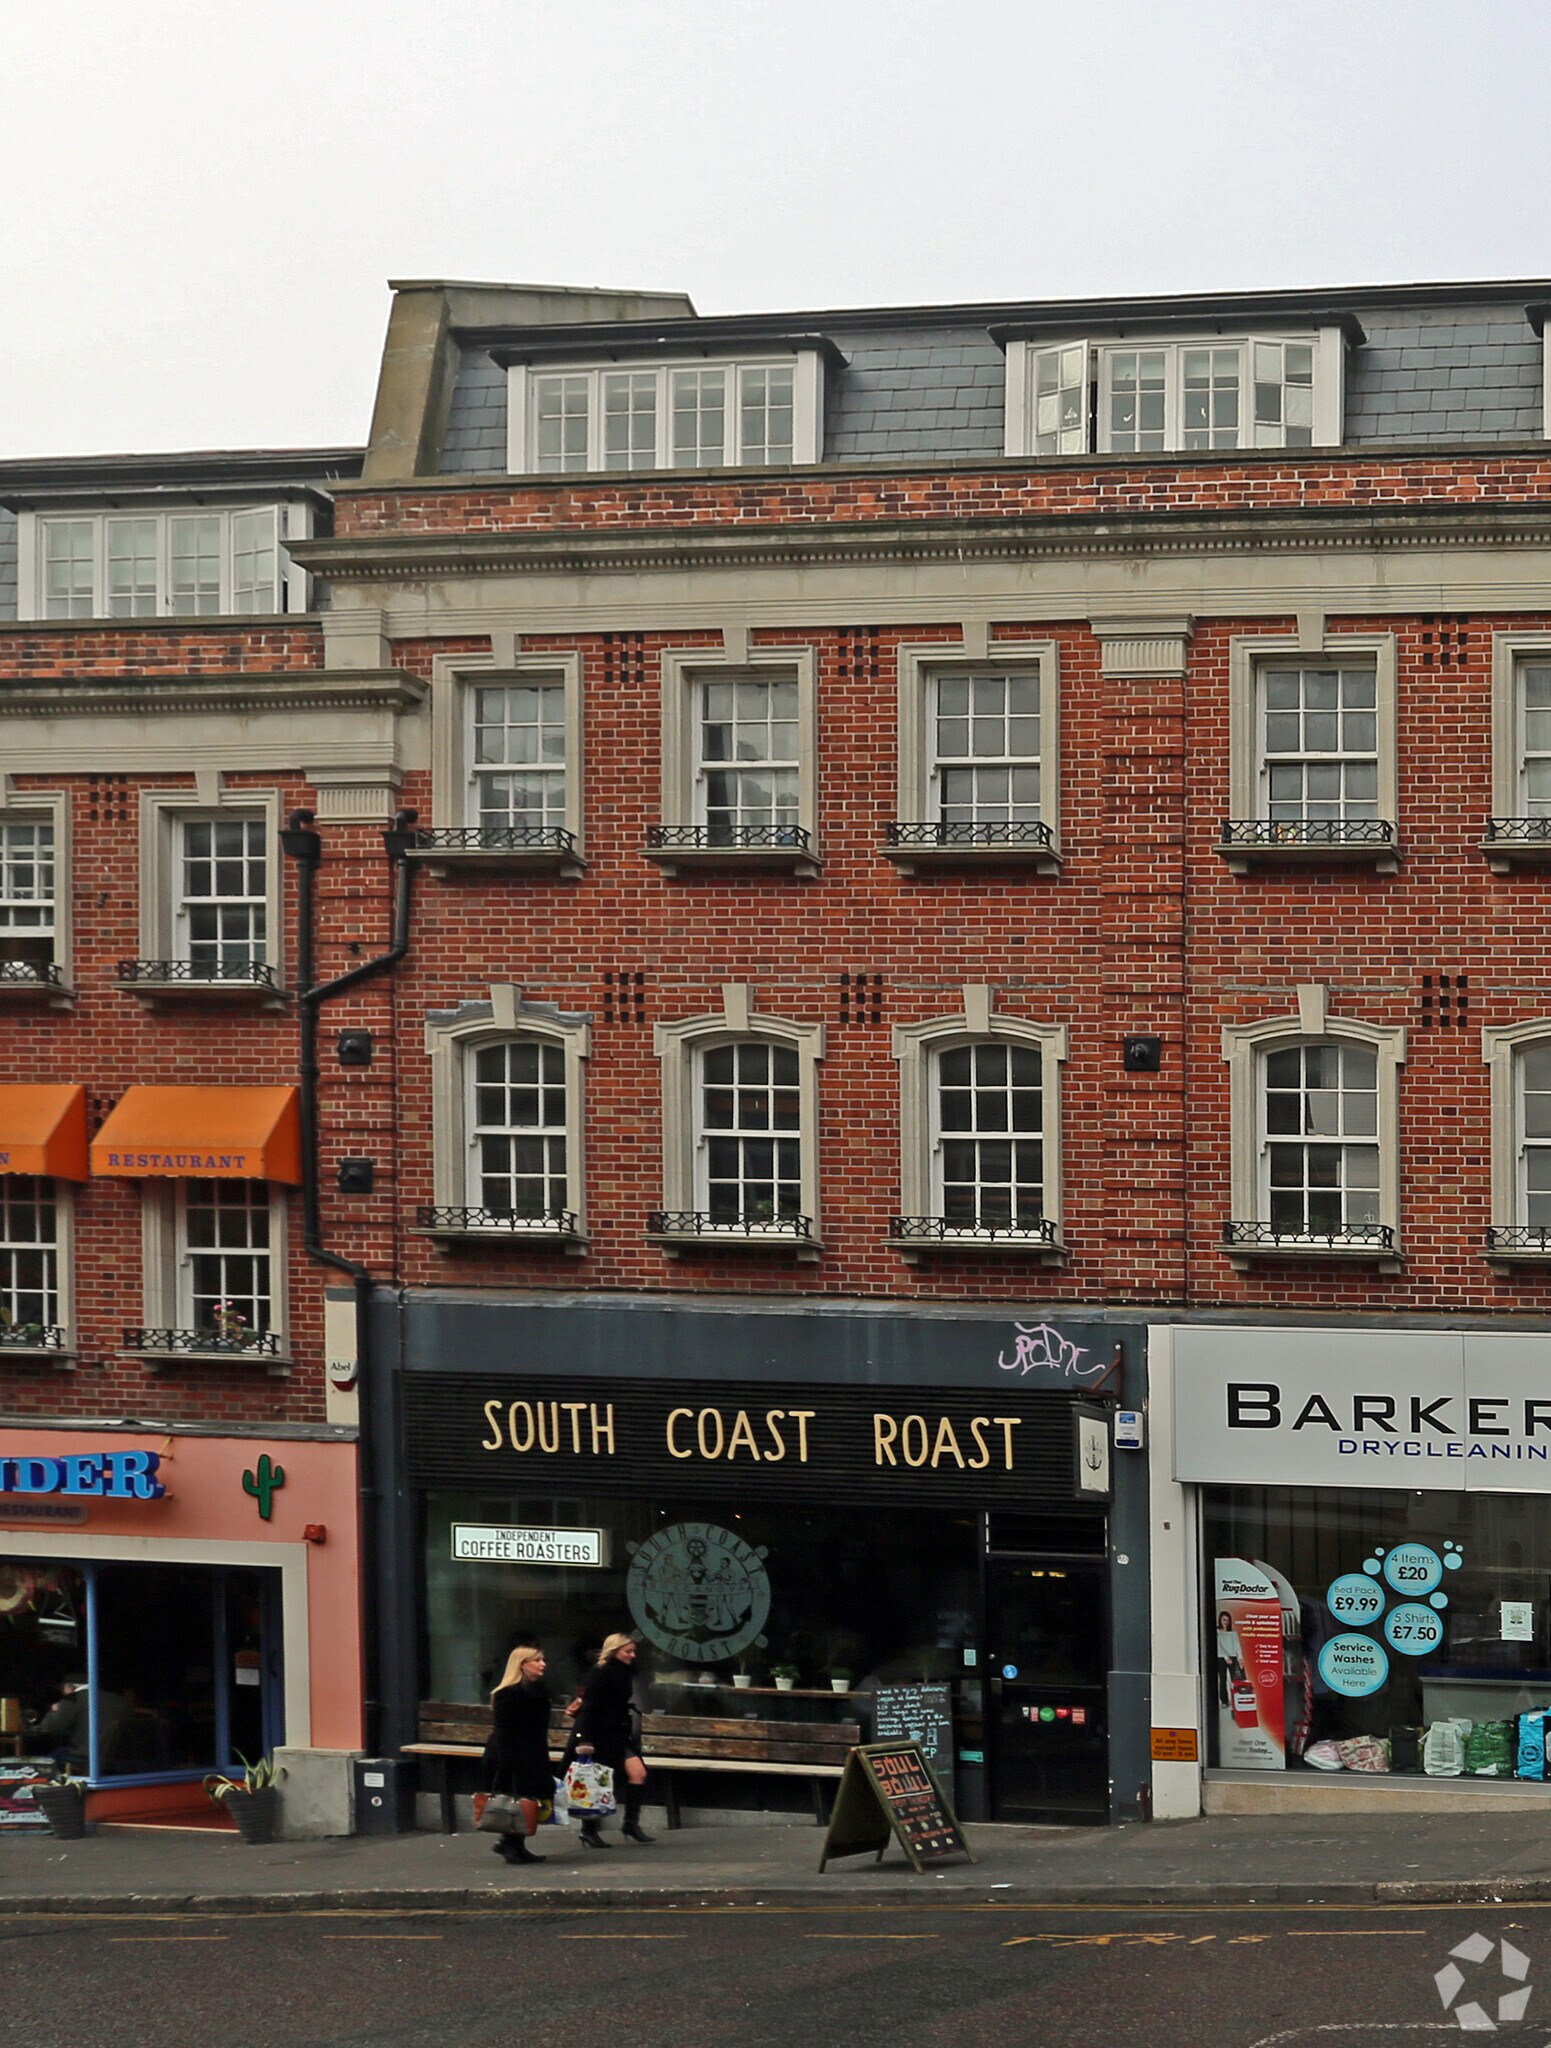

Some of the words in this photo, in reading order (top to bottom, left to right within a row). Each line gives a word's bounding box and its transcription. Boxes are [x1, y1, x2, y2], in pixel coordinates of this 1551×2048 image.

[107, 1153, 246, 1169] RESTAURANT
[481, 1400, 615, 1455] SOUTH
[665, 1408, 816, 1463] COAST
[873, 1413, 1021, 1470] ROAST
[1338, 1439, 1548, 1460] DRYCLEANIN
[495, 1530, 556, 1542] INDEPENDENT
[461, 1540, 511, 1557] COFFEE
[516, 1543, 591, 1560] ROASTERS
[631, 1524, 687, 1573] SOUTH
[705, 1525, 765, 1575] COAST
[1391, 1554, 1398, 1563] 4
[1402, 1554, 1435, 1564] Items
[1398, 1567, 1428, 1581] £20
[1334, 1586, 1351, 1594] Bed
[1355, 1587, 1378, 1595] Pack
[1335, 1597, 1379, 1611] £9.99
[1394, 1613, 1402, 1622] 5
[1405, 1613, 1435, 1624] Shirts
[1392, 1626, 1436, 1640] £7.50
[667, 1636, 732, 1662] ROAST
[1333, 1643, 1373, 1653] Service
[1333, 1654, 1375, 1664] Washes
[1331, 1667, 1377, 1676] Available
[1342, 1679, 1366, 1687] Here
[872, 1755, 920, 1777] SOUL
